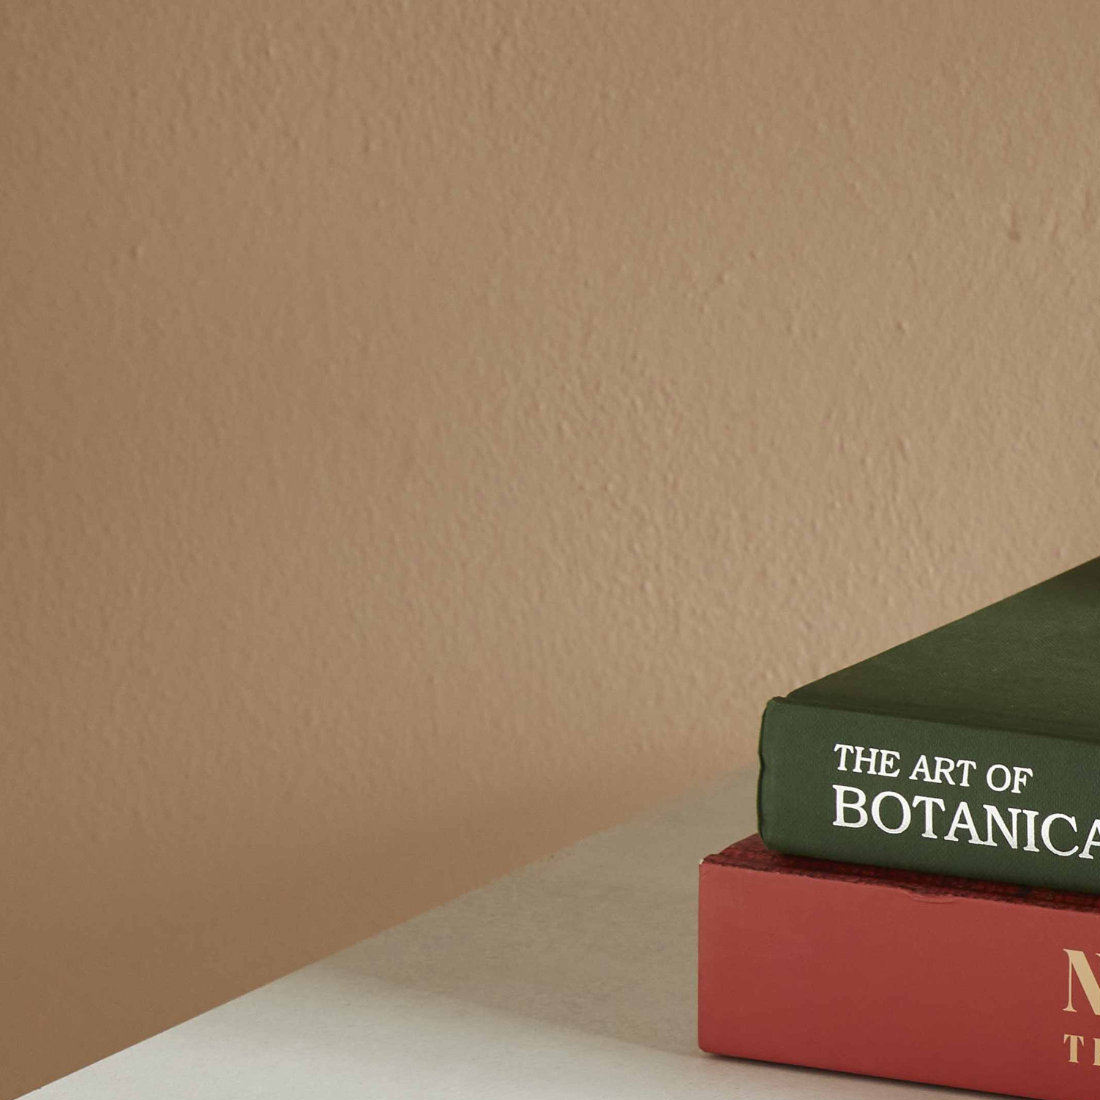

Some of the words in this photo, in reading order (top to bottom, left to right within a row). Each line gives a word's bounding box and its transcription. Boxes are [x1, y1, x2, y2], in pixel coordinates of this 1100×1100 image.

[833, 743, 901, 778] THE
[908, 754, 977, 788] ART
[986, 763, 1034, 794] OF
